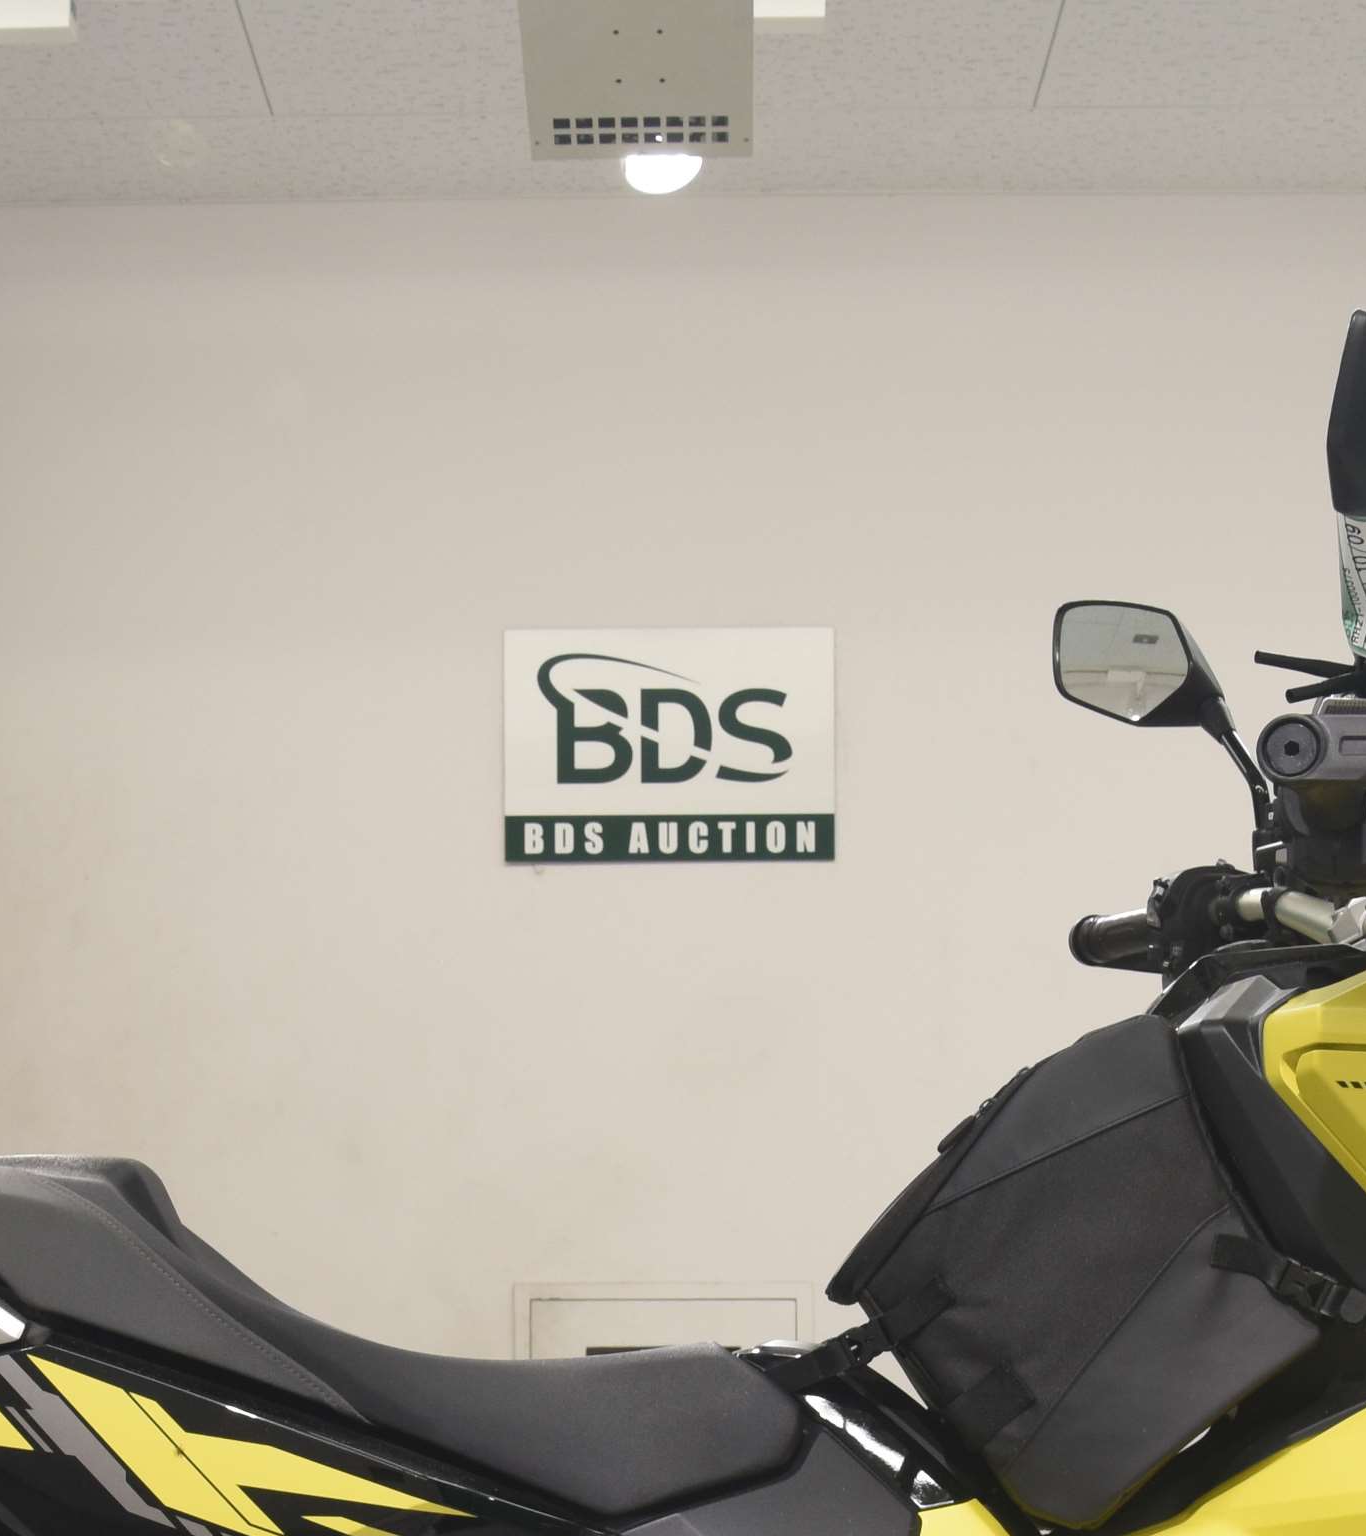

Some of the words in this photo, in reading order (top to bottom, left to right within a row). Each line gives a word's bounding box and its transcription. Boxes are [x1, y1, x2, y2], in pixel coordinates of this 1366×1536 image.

[537, 653, 793, 784] BDS
[523, 821, 604, 855] BDS
[628, 820, 817, 854] AUCTION
